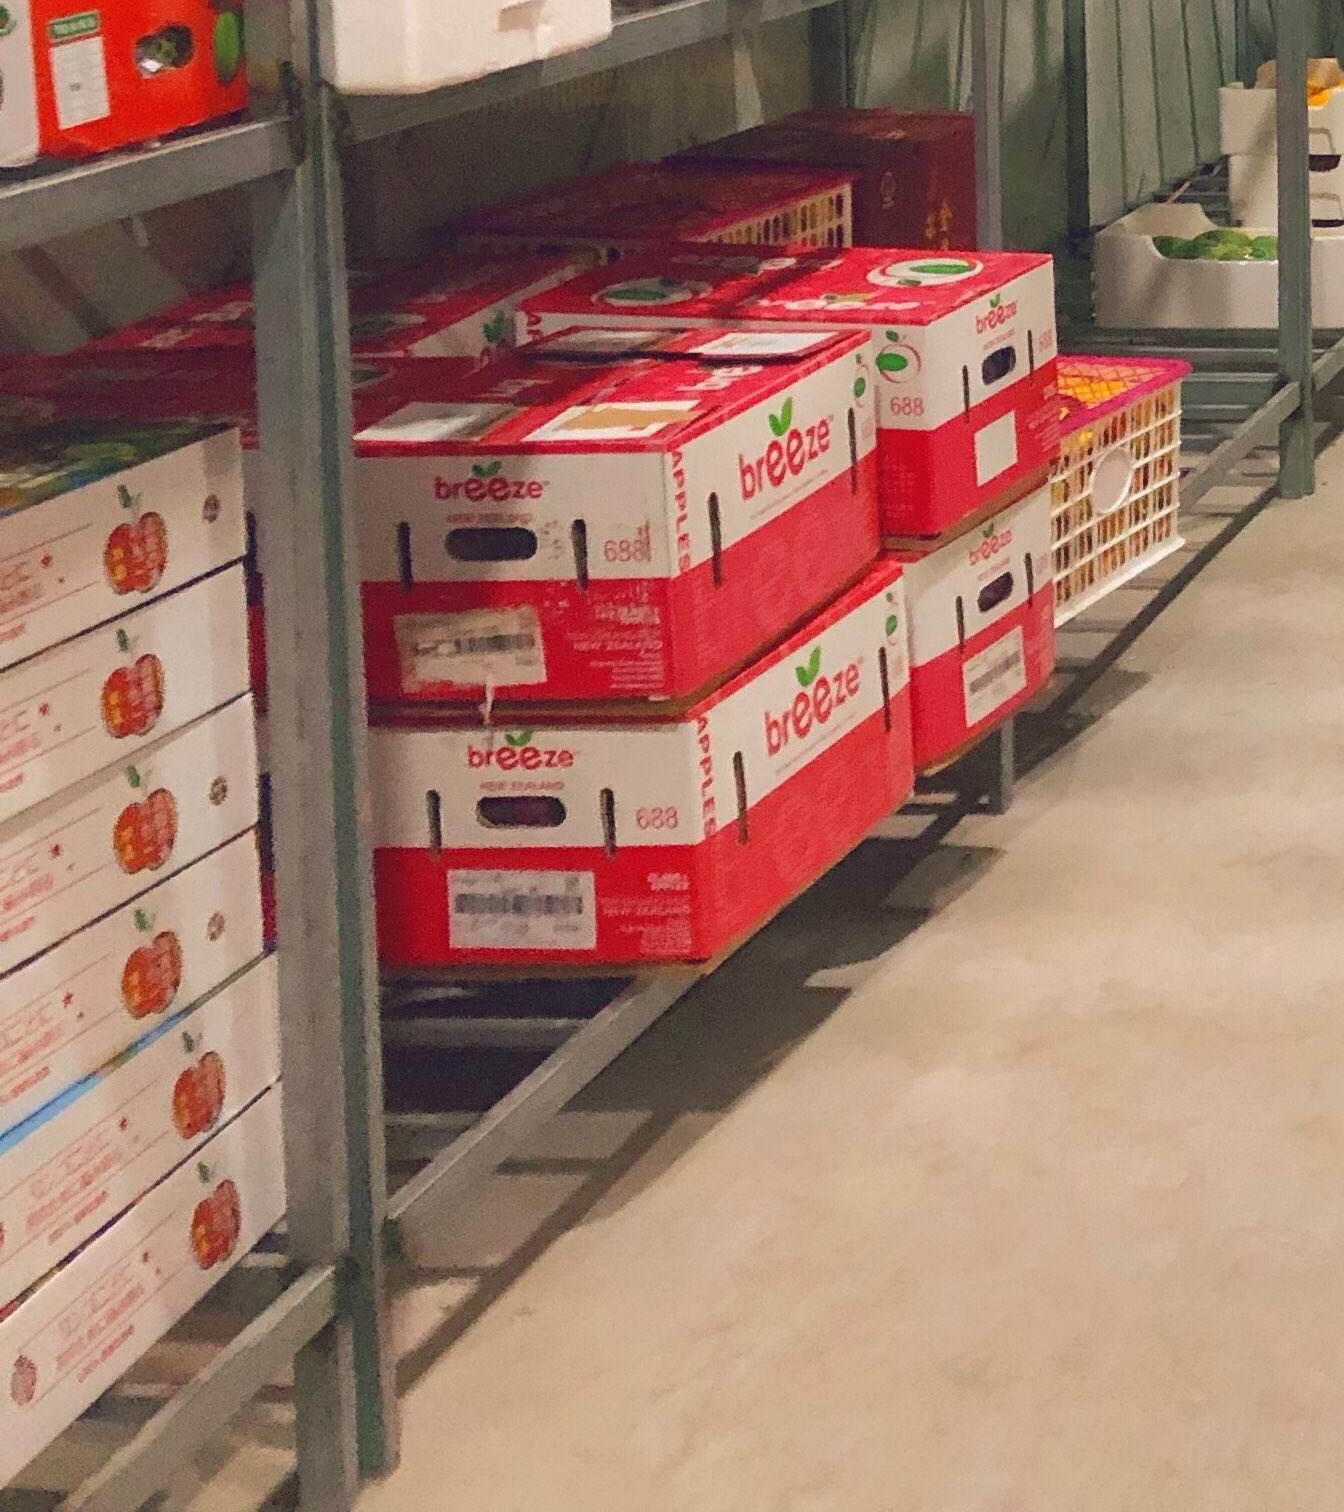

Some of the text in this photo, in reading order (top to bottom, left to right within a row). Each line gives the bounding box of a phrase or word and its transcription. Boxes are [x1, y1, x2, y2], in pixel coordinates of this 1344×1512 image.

[890, 396, 924, 416] 688
[738, 418, 831, 501] breeze
[434, 475, 544, 502] breeze
[672, 451, 690, 573] APPLES
[604, 539, 646, 563] 688
[764, 663, 861, 758] breeze
[467, 744, 574, 770] breeze
[697, 716, 718, 839] APPLES
[635, 805, 679, 829] 688
